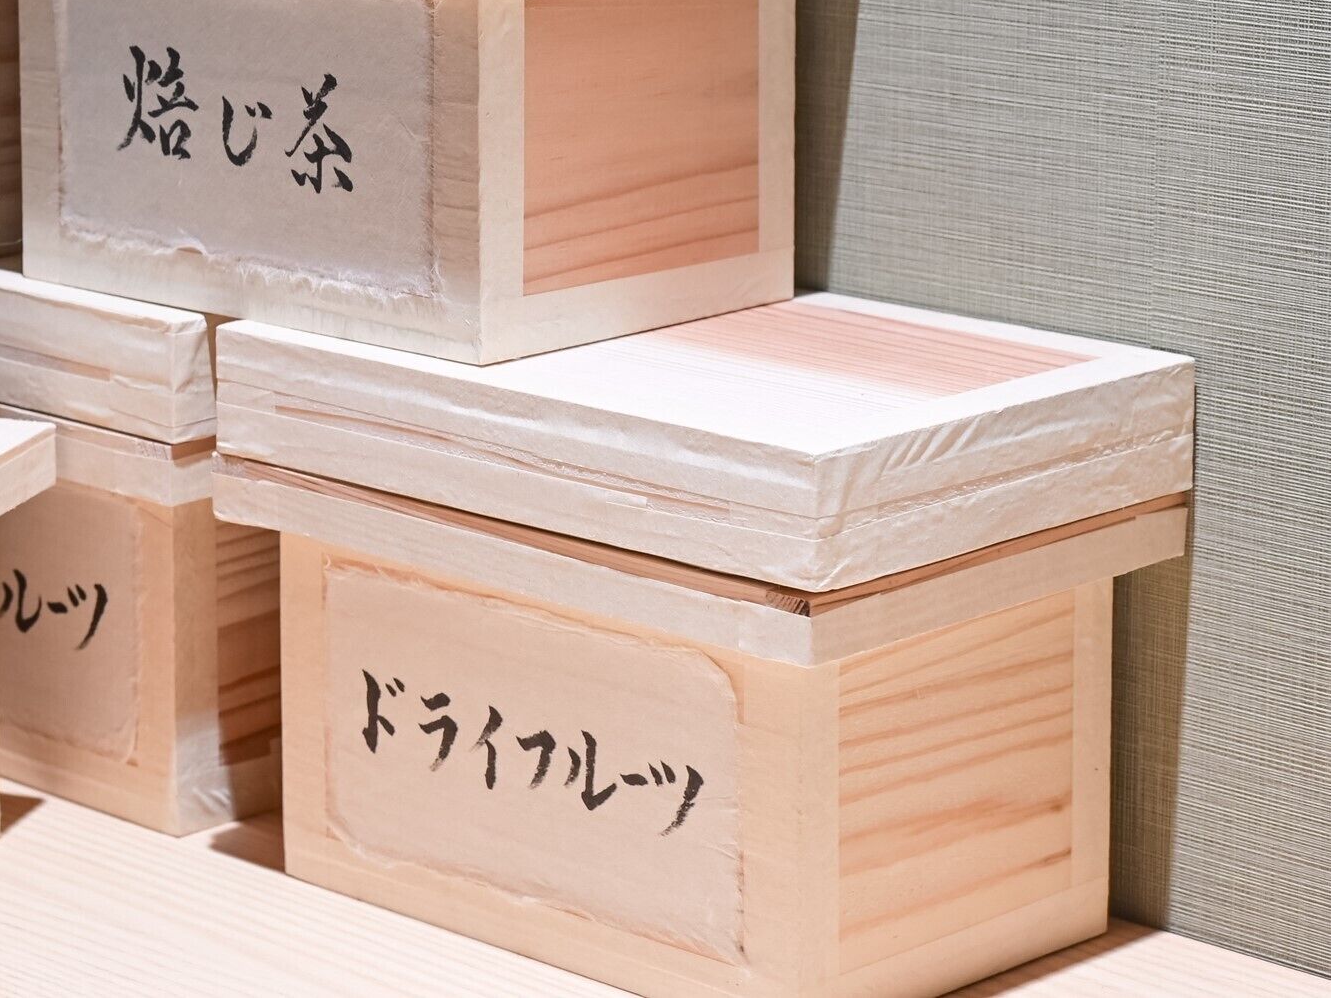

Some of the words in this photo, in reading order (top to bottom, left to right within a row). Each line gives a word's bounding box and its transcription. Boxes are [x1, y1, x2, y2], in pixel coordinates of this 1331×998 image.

[117, 45, 354, 195] 焙じ茶
[361, 668, 705, 837] ドライフルーツ
